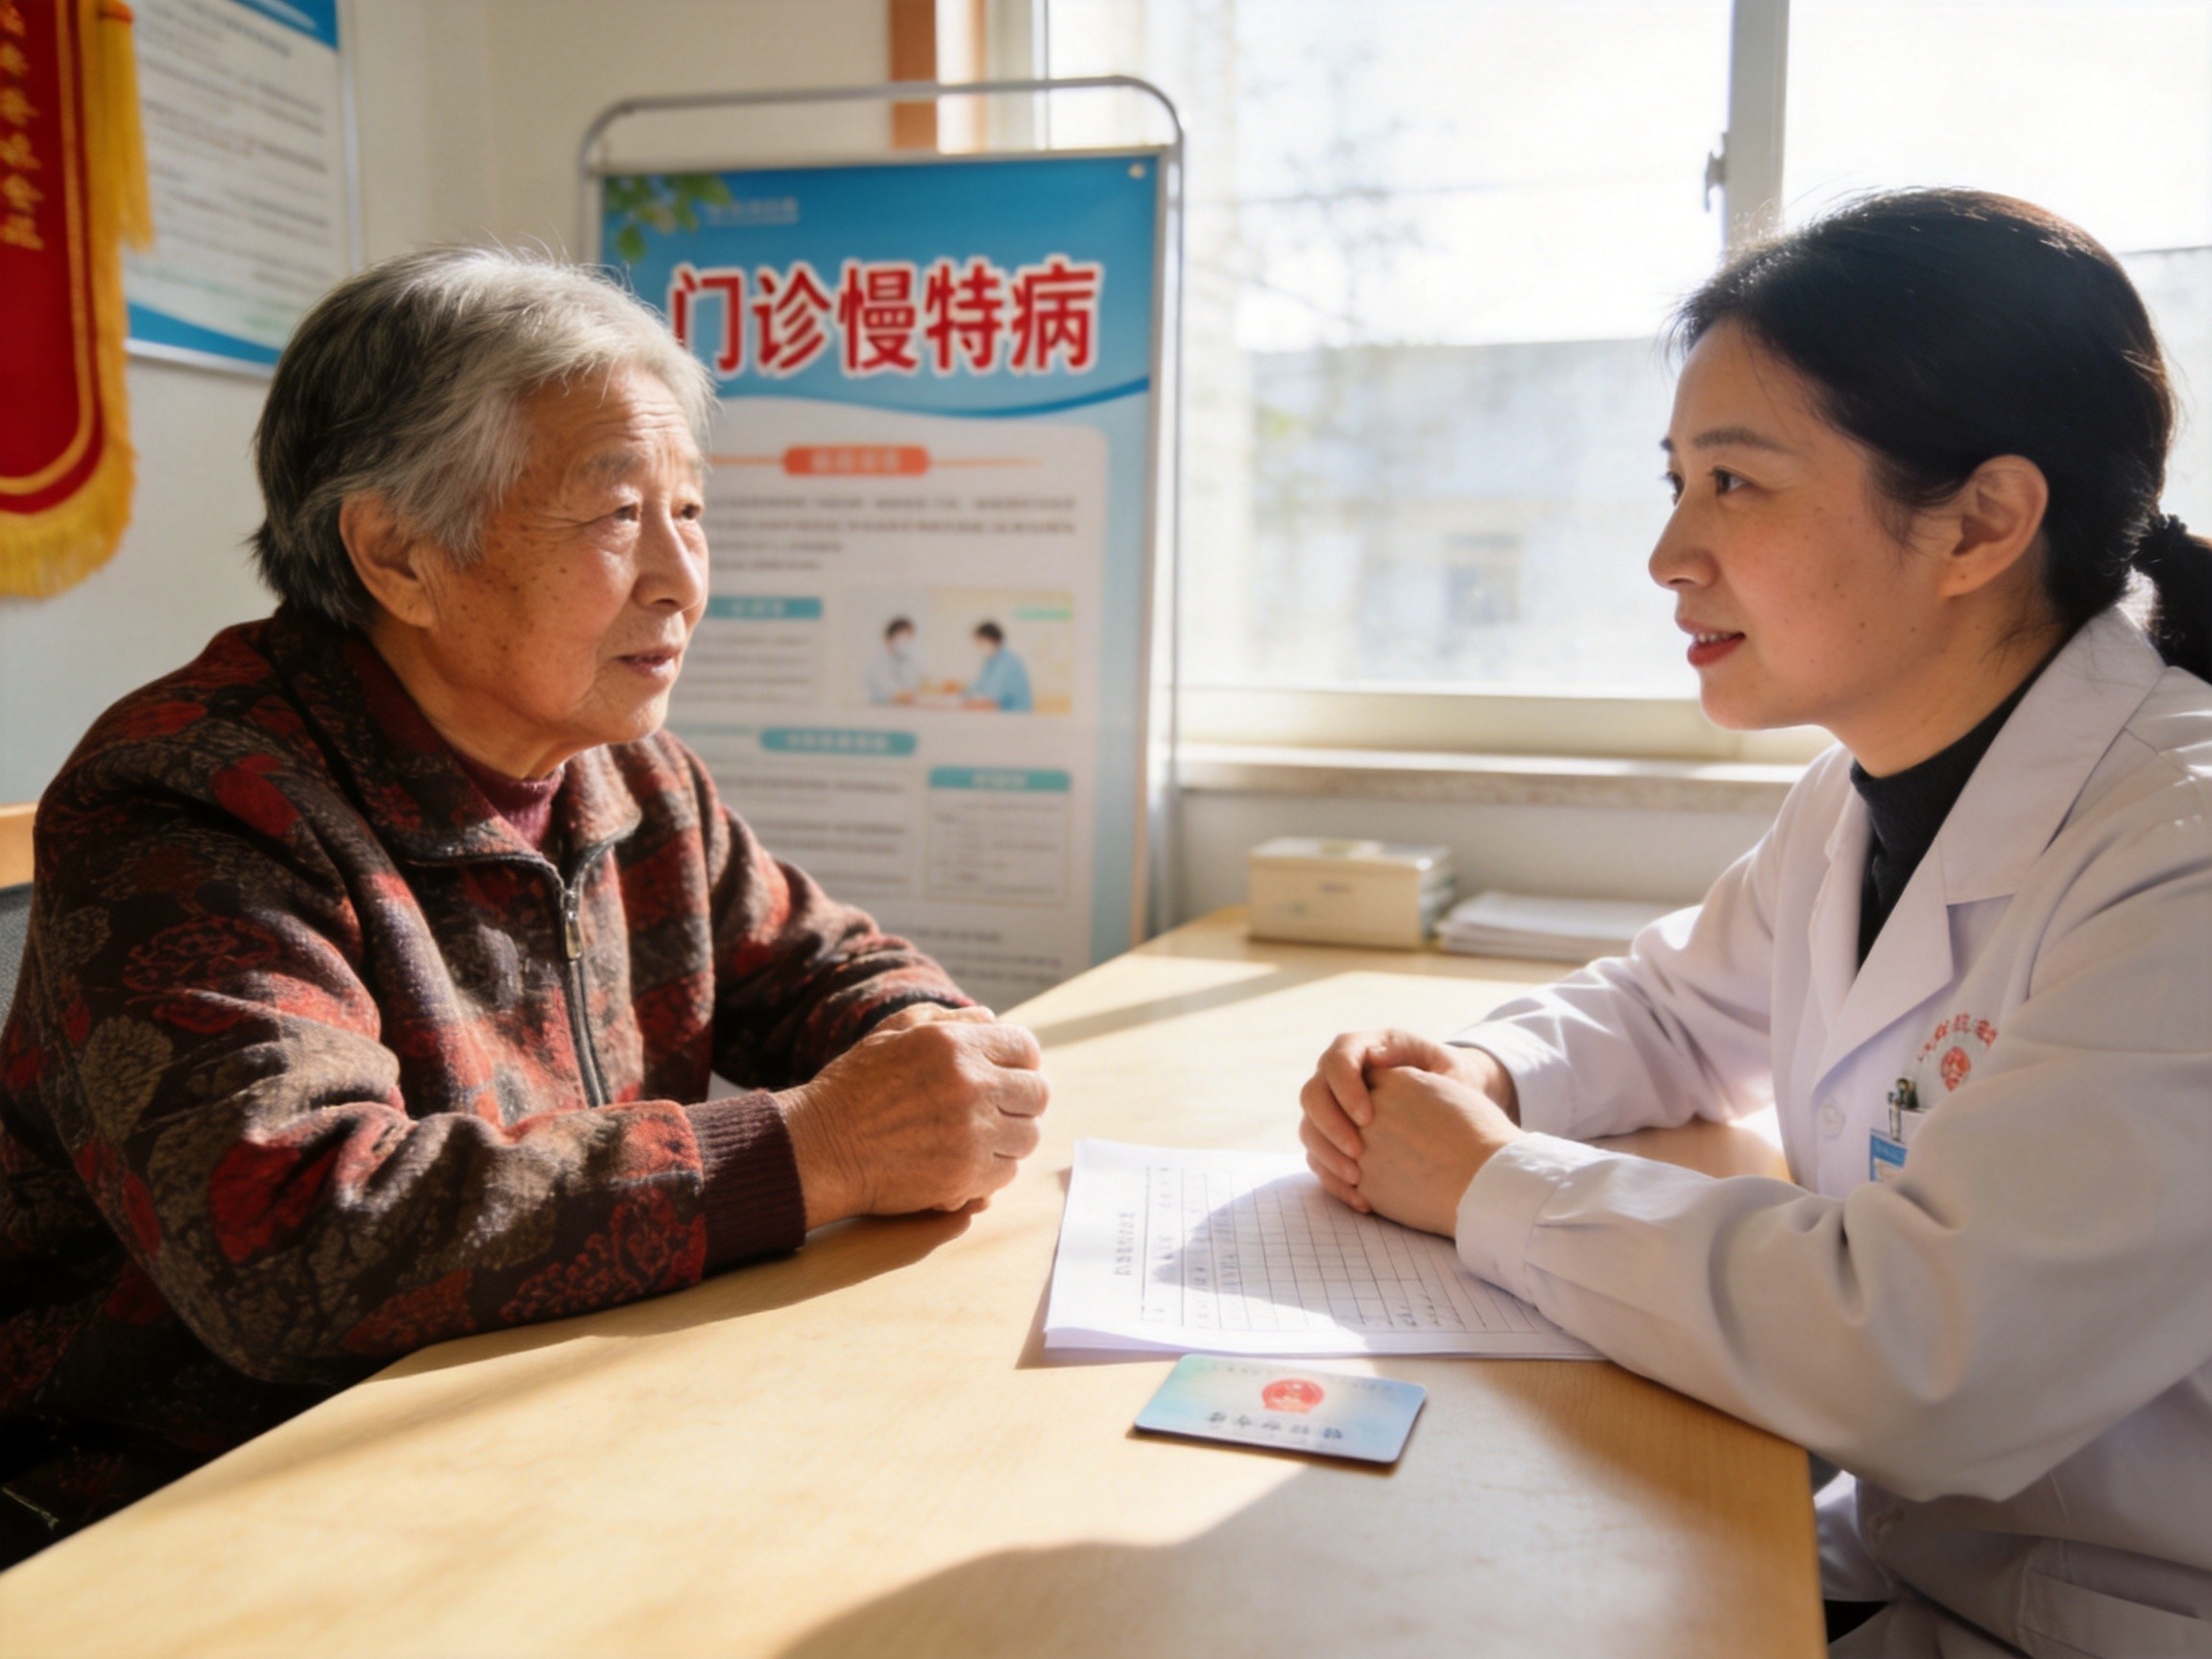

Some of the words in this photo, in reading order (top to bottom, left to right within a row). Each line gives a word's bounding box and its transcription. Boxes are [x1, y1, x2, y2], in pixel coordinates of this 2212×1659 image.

[671, 257, 1100, 374] 门诊慢特病
